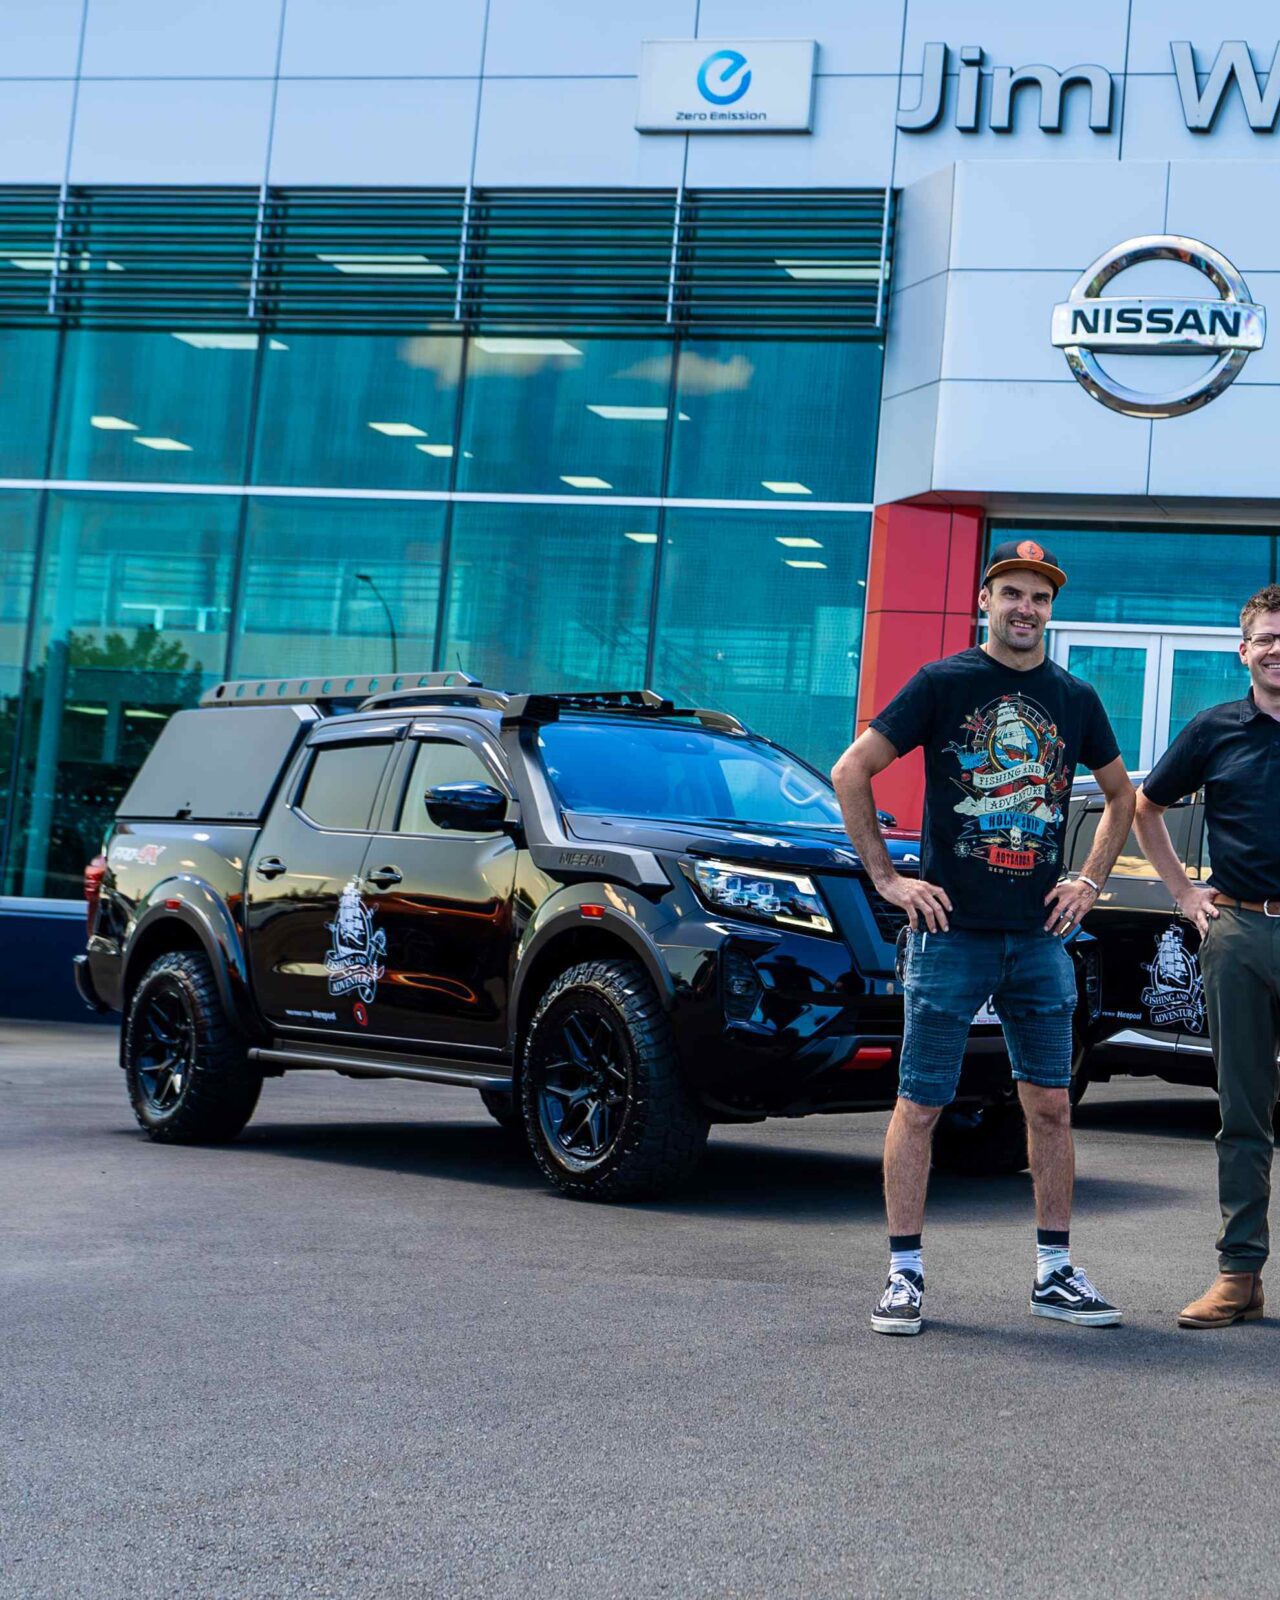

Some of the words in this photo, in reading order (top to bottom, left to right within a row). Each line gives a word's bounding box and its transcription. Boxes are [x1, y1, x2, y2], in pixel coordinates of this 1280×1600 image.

[896, 42, 1114, 134] Jim
[676, 111, 708, 121] Zero
[710, 110, 767, 121] Emission
[1071, 308, 1241, 337] NISSAN
[979, 768, 1022, 786] FISHING
[1023, 764, 1042, 775] AND
[989, 786, 1043, 810] ADVENTURE
[989, 814, 1015, 828] HOLY
[560, 852, 606, 866] NISSAN
[326, 956, 354, 972] FISHING
[332, 976, 372, 993] ADVENTURE
[1144, 992, 1175, 1005] FISHING
[1176, 993, 1189, 1001] AND
[1155, 1008, 1198, 1023] ADVENTURE
